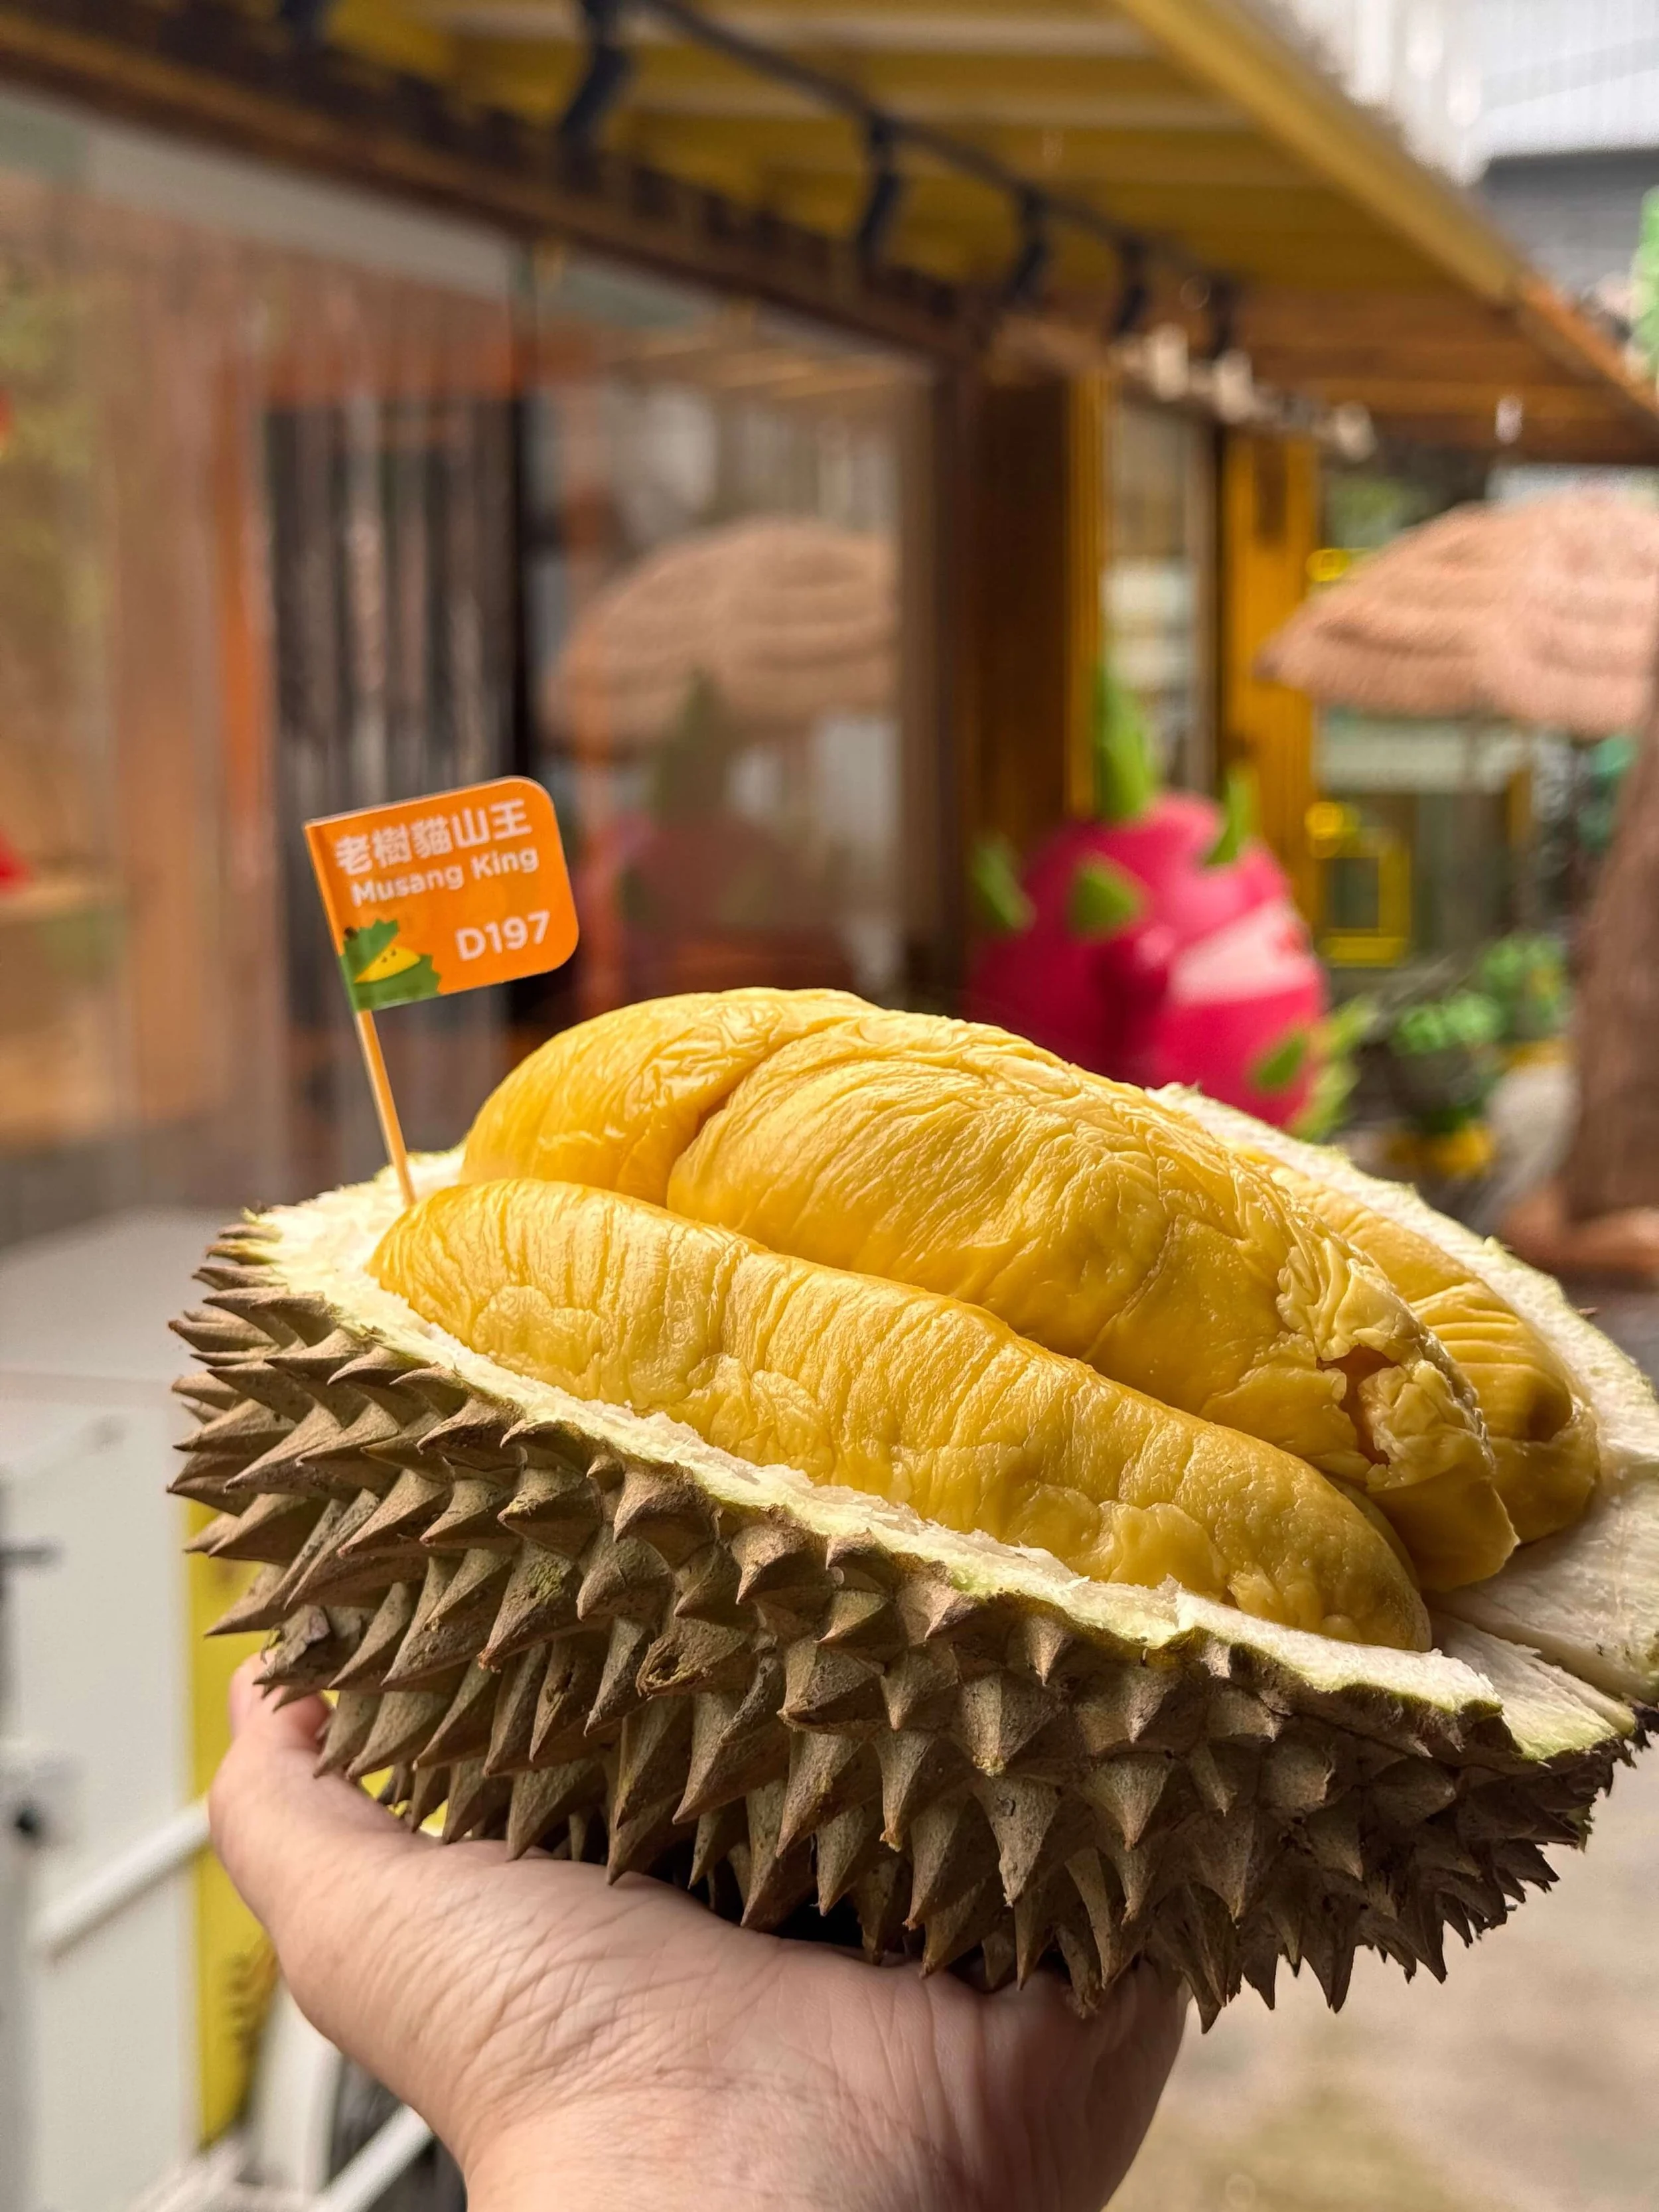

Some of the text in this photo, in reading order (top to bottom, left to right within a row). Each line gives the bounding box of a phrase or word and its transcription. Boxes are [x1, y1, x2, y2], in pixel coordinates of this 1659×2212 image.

[335, 799, 532, 875] 老樹貓山王
[351, 848, 539, 907] Musang King
[455, 911, 550, 961] D197
